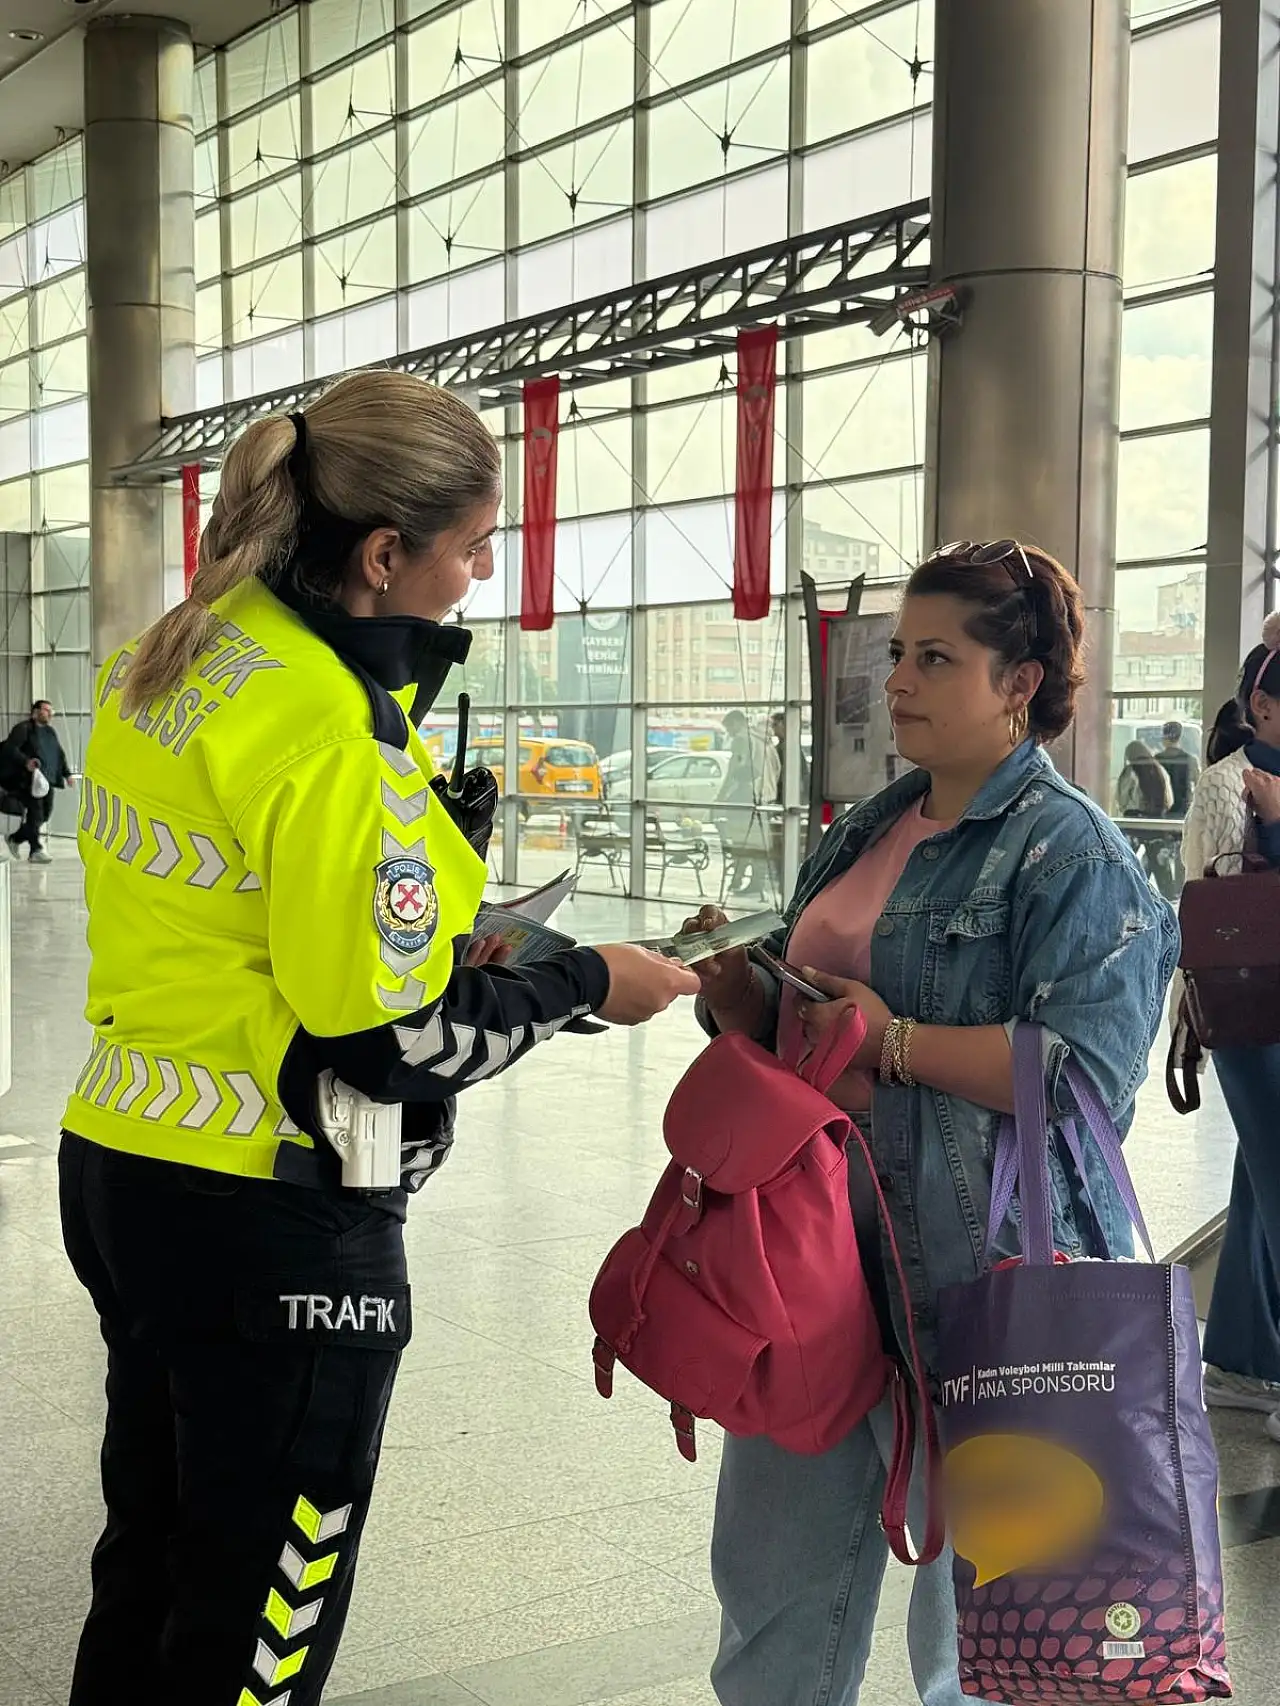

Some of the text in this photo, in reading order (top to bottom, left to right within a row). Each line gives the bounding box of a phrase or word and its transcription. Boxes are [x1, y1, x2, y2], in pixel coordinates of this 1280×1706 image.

[998, 1364, 1040, 1377] Voleybol
[1042, 1362, 1064, 1373] Milli
[1066, 1361, 1116, 1372] Takımlar
[977, 1374, 1115, 1400] ANA SPONSORU
